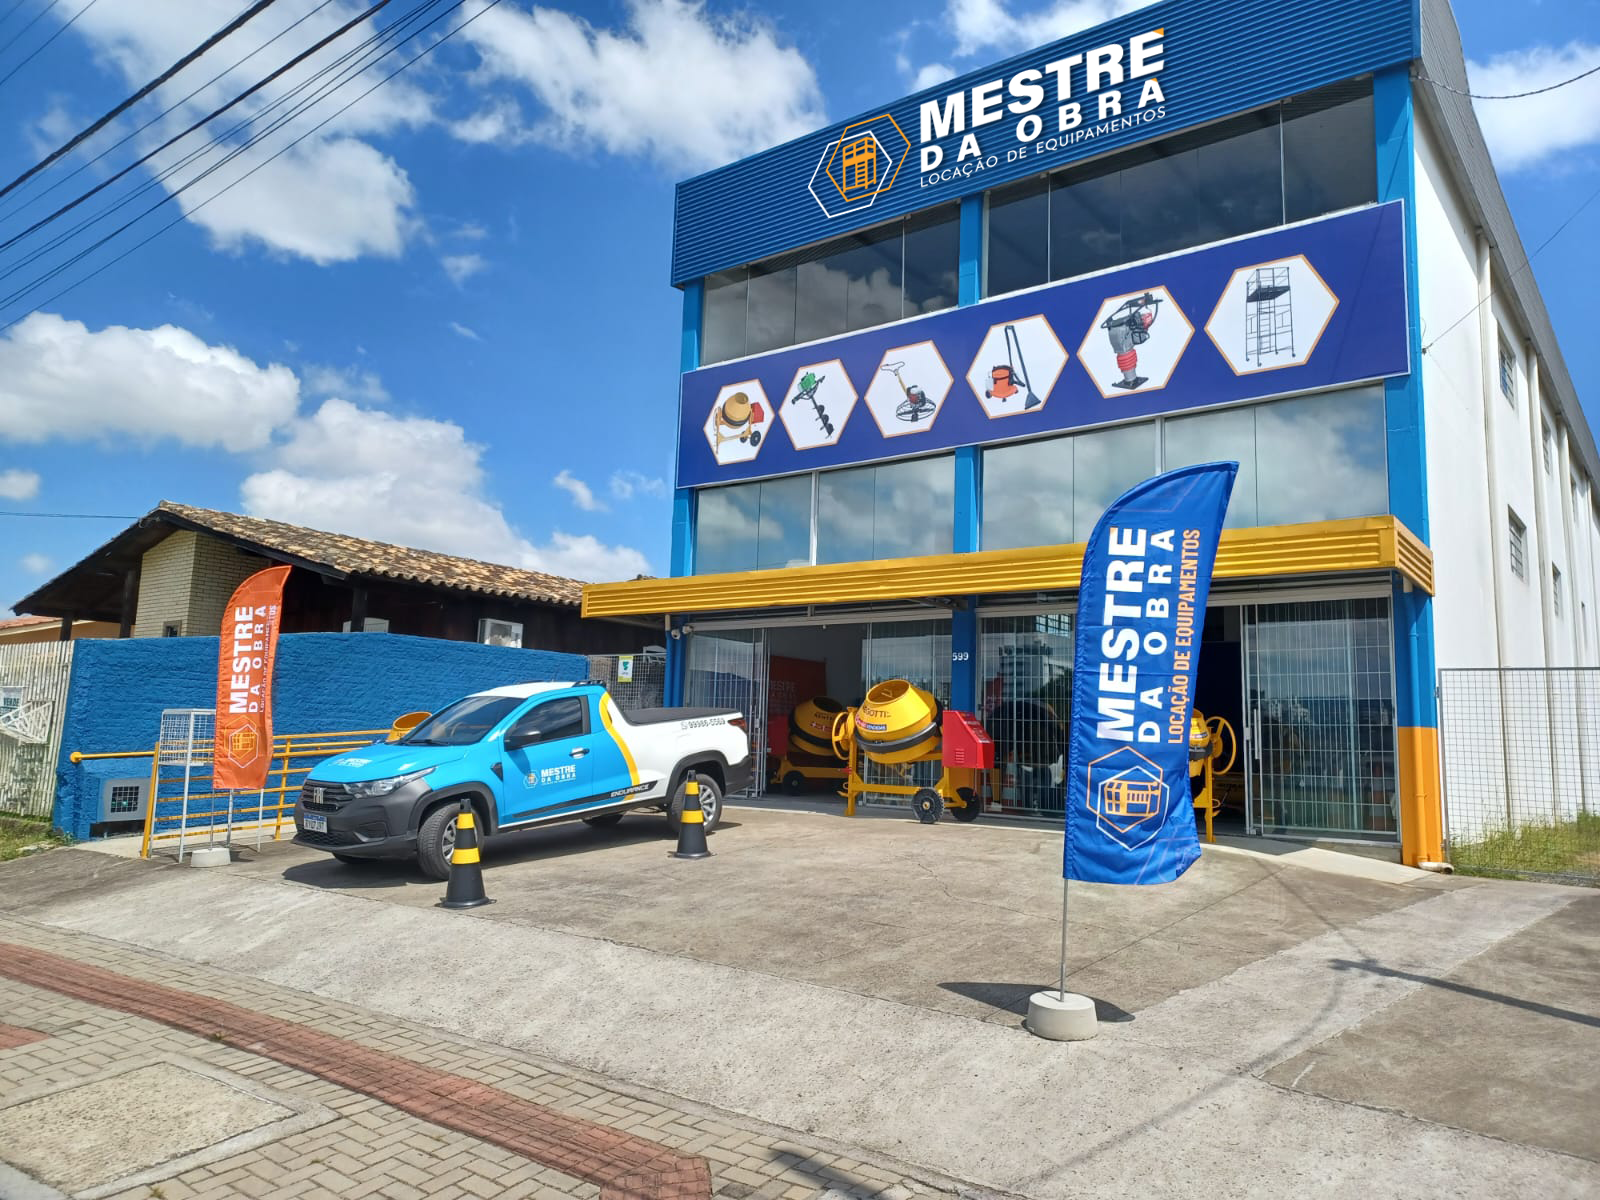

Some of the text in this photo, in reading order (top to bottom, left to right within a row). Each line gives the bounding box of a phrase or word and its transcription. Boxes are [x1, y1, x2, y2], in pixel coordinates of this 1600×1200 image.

[920, 28, 1164, 144] MESTRE
[920, 78, 1166, 173] DA OBRA
[920, 106, 1166, 188] LOCAÇÃO DE EQUIPAMENTOS
[229, 606, 253, 713] MESTRE
[248, 606, 267, 713] DA OBRA
[952, 651, 969, 661] 599
[1096, 527, 1147, 742] MESTRE
[1138, 528, 1175, 743] DA OBRA
[1167, 529, 1201, 744] LOCAÇÃO DE EQUIPAMENTOS
[541, 764, 576, 777] MESTRE
[610, 783, 650, 798] ENDURANCE
